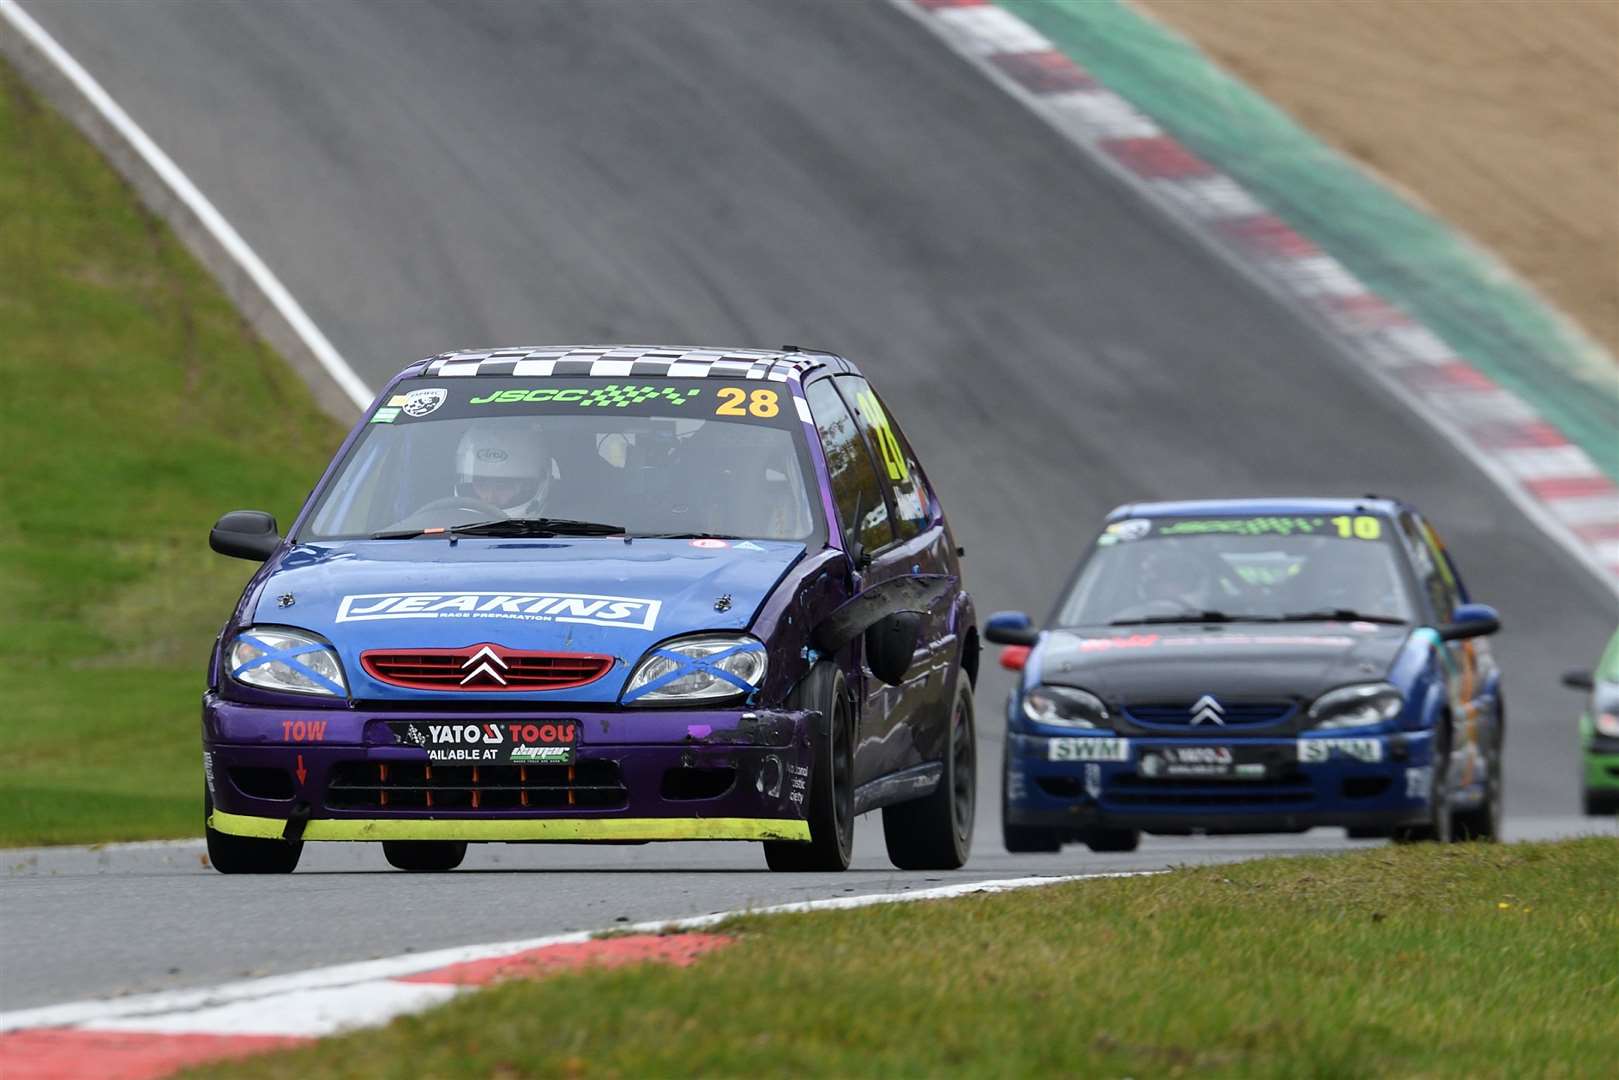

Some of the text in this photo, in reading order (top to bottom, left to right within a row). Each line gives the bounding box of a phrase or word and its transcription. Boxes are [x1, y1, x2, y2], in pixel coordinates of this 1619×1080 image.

[469, 389, 588, 404] JSCC
[715, 388, 779, 417] 28
[1331, 516, 1380, 539] 10
[350, 595, 642, 619] JEAKINS
[473, 612, 552, 622] PREPARATION
[282, 720, 327, 742] TOW
[428, 724, 574, 744] YATO TOOLS
[428, 749, 498, 760] AILABLE AT
[1056, 741, 1121, 757] SWM
